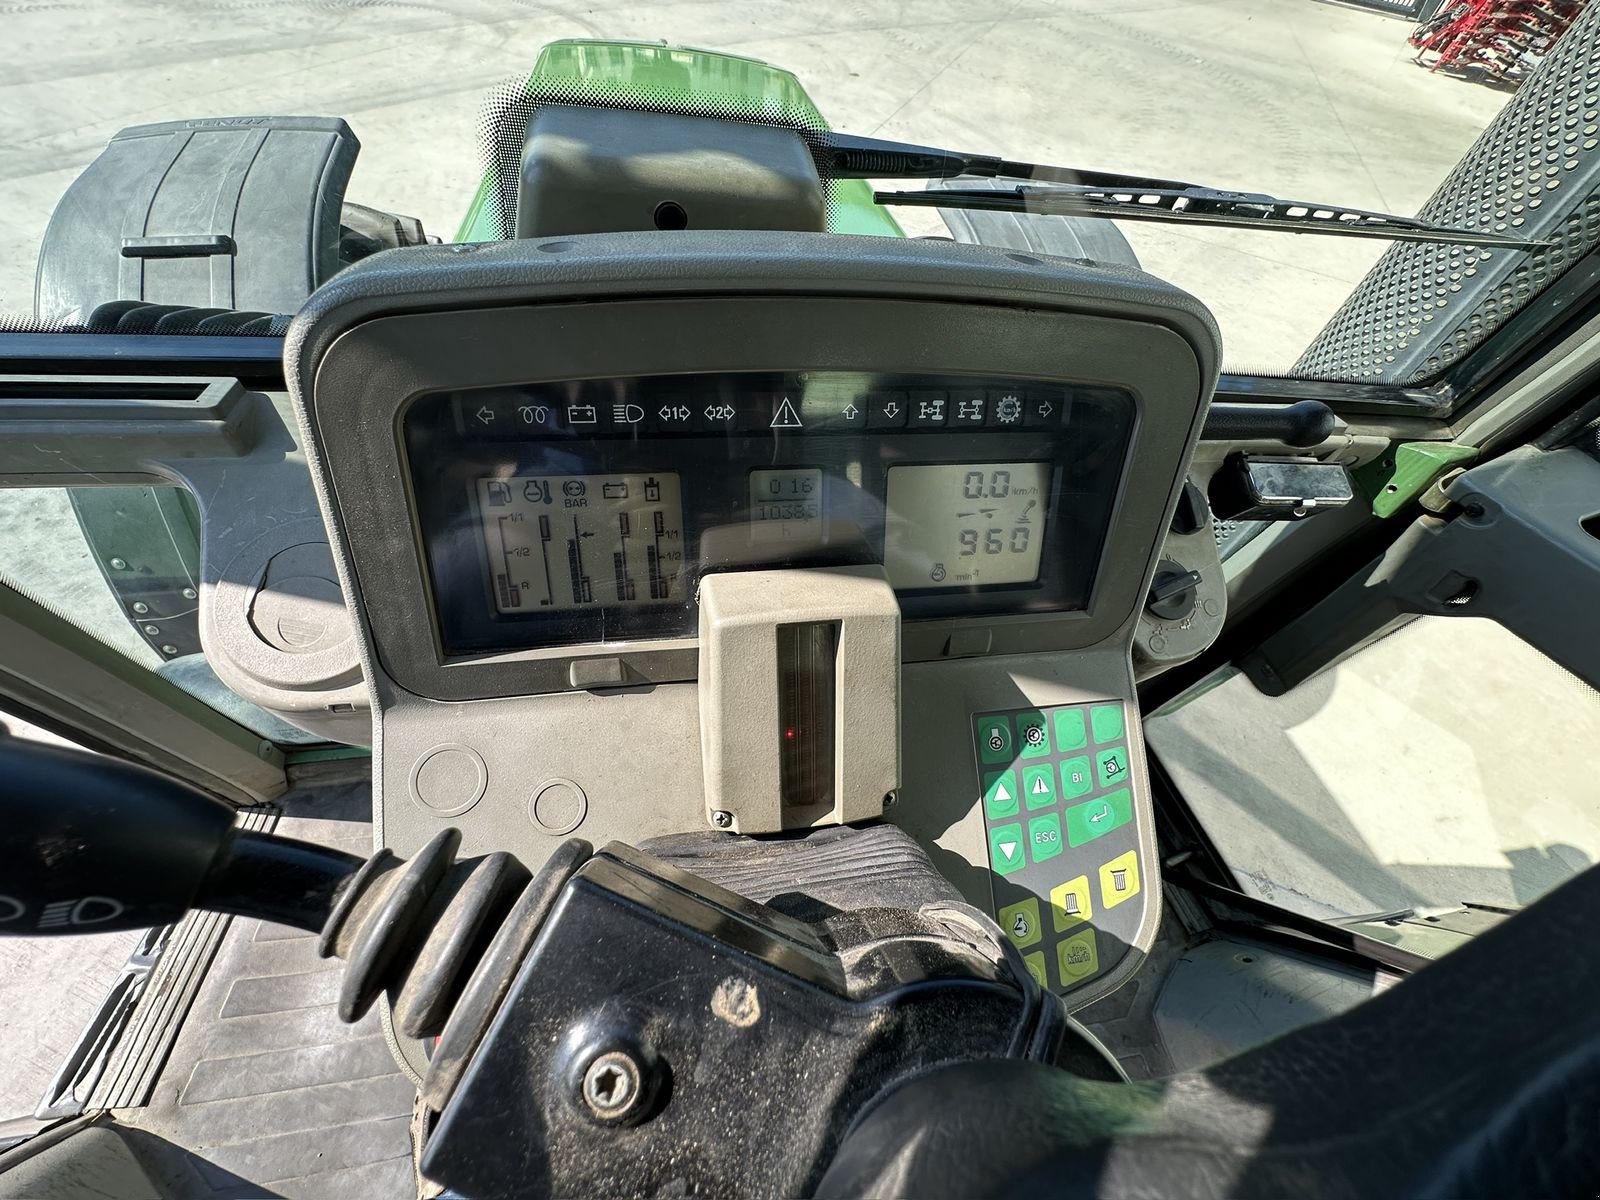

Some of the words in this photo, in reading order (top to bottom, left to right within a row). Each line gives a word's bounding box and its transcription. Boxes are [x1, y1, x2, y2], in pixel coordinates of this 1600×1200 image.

[964, 471, 1011, 500] 0.0
[564, 499, 588, 509] BAR
[509, 513, 524, 522] 1/1
[665, 530, 679, 539] 1/1
[959, 528, 1031, 557] 960
[513, 546, 531, 555] 1/2
[667, 551, 682, 561] 1/2
[1035, 831, 1058, 843] ESC
